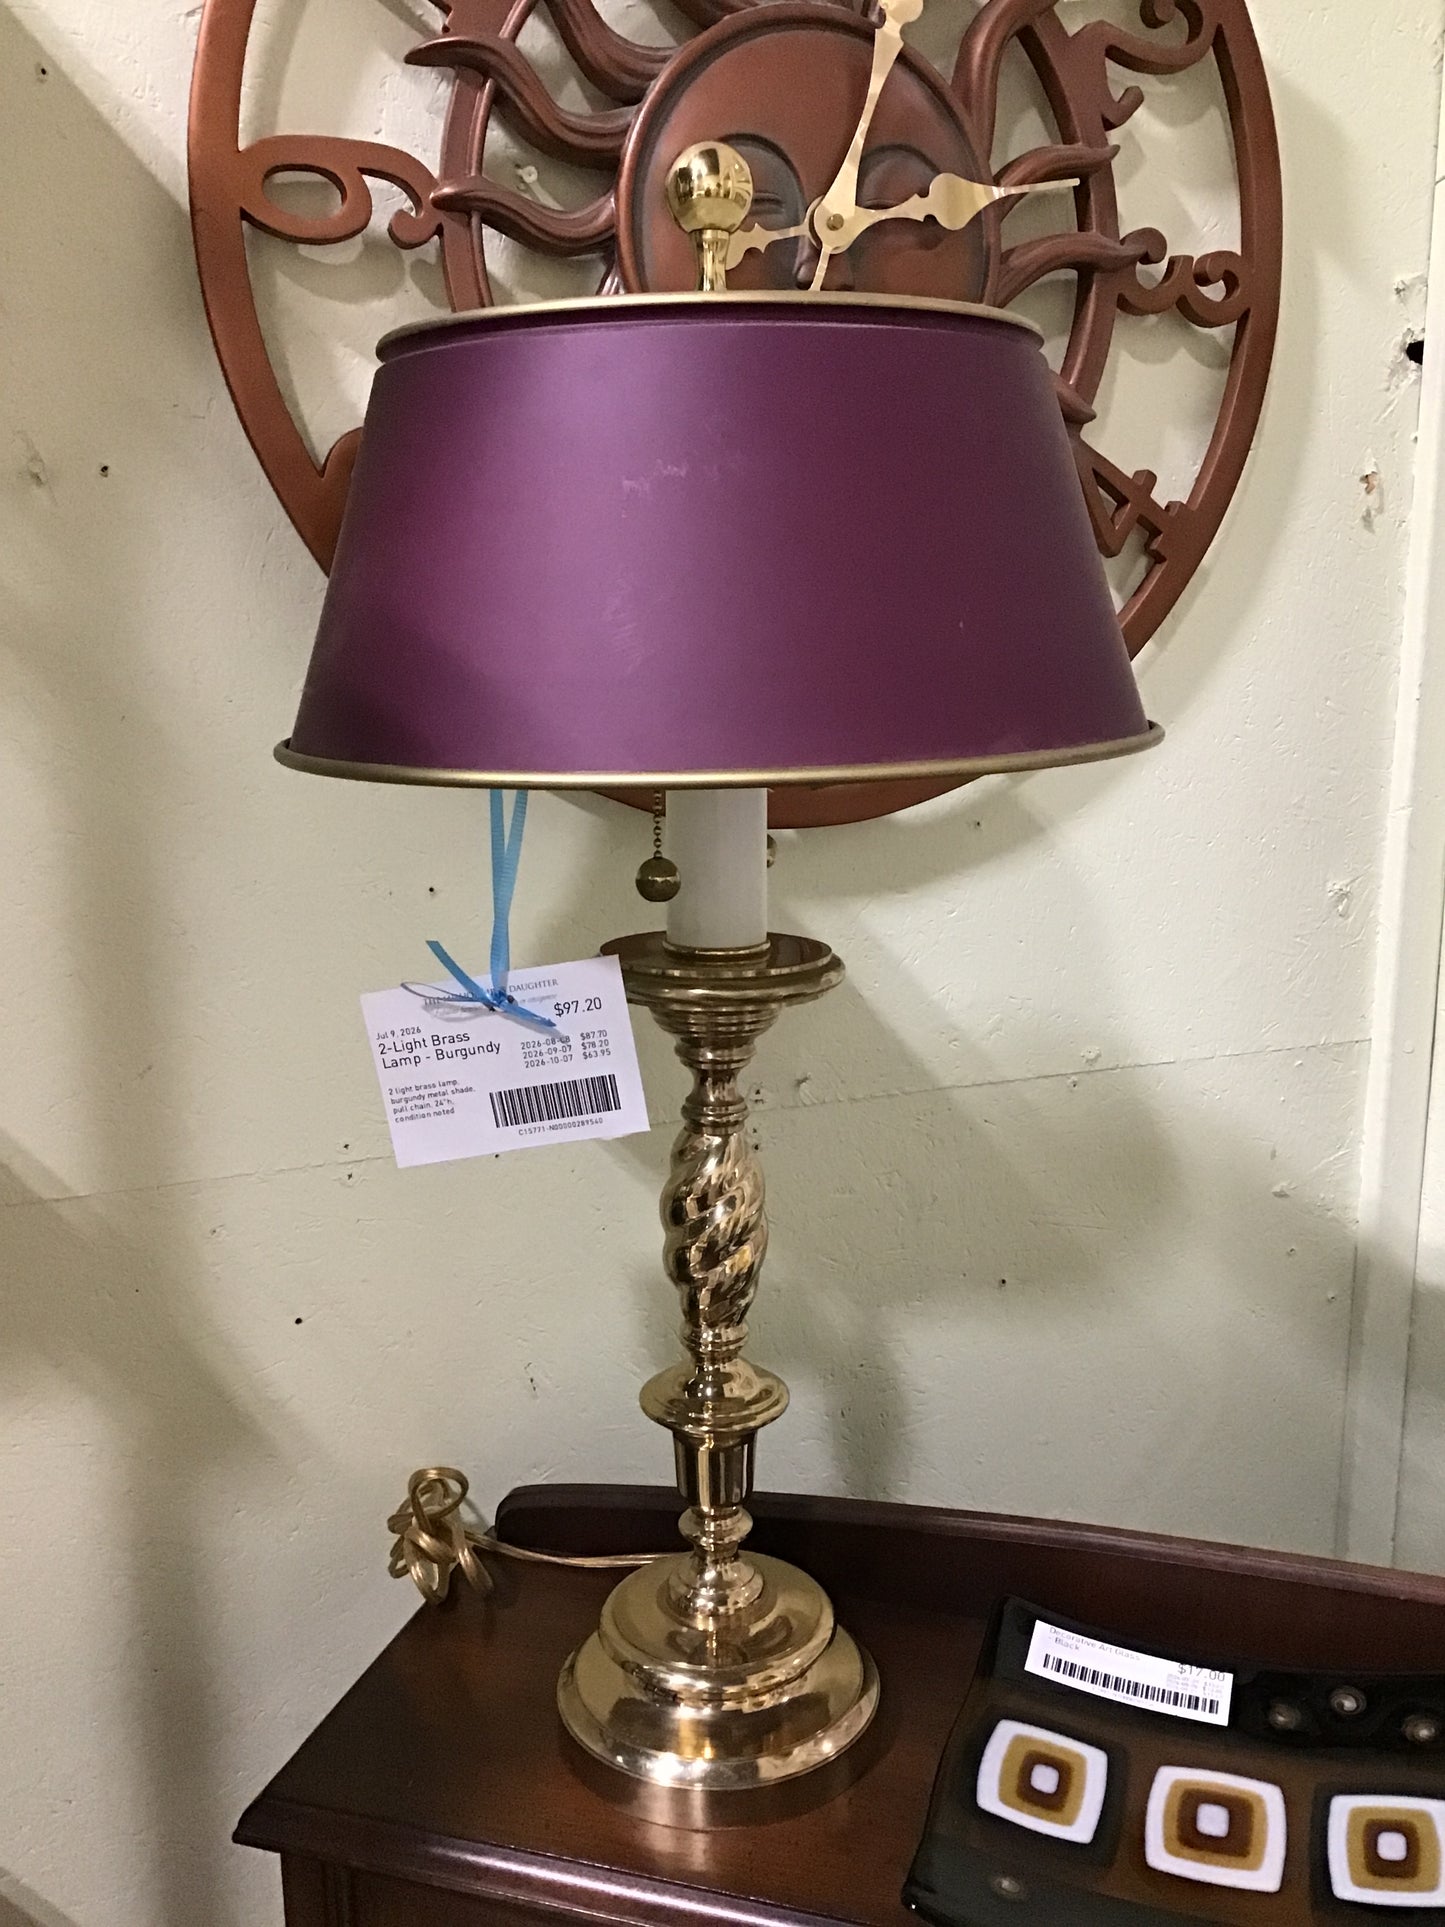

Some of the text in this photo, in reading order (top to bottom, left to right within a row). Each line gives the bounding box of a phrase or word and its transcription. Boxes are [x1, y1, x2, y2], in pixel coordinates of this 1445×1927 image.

[509, 978, 559, 993] DAUGHTER
[554, 997, 602, 1017] $97.20
[376, 1031, 389, 1040] Jul
[400, 1026, 422, 1037] 2026
[378, 1032, 471, 1055] 2-Light Brass
[382, 1055, 422, 1069] Lamp
[435, 1041, 501, 1061] Burgundy
[522, 1045, 572, 1060] 2026-09-07
[524, 1054, 573, 1068] 2026-10-07
[395, 1086, 413, 1095] light
[415, 1082, 437, 1091] brass
[390, 1094, 426, 1105] burgundy
[427, 1090, 449, 1099] metal
[393, 1106, 408, 1115] pull
[395, 1107, 455, 1123] condition noted
[1049, 1626, 1097, 1648] Decorative
[1098, 1643, 1113, 1654] Art
[1054, 1637, 1080, 1651] Black
[1177, 1663, 1226, 1682] $17.00
